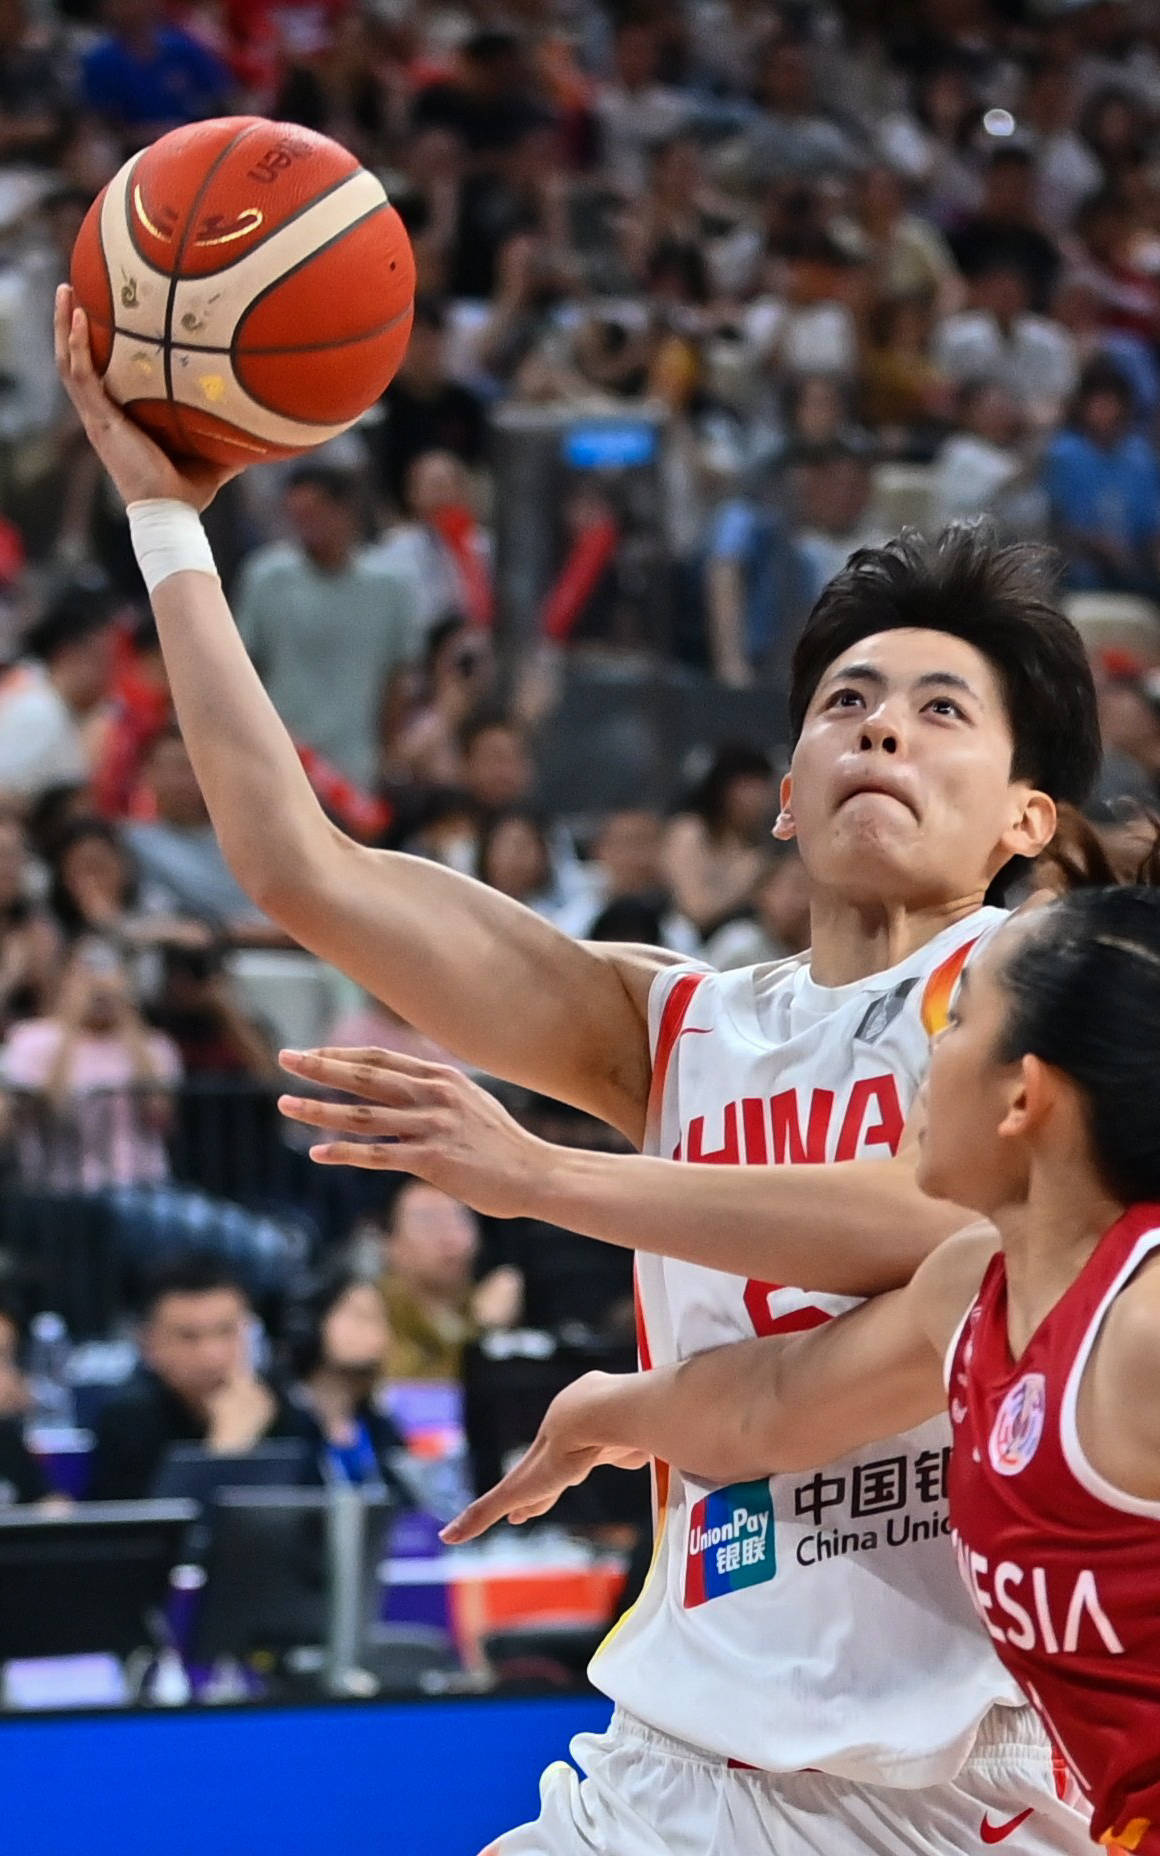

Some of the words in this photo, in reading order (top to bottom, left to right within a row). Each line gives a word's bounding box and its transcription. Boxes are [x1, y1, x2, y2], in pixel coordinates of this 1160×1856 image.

[673, 1073, 905, 1165] HINA
[689, 1507, 770, 1556] UnionPay
[796, 1528, 878, 1567] China
[715, 1535, 766, 1575] 银联
